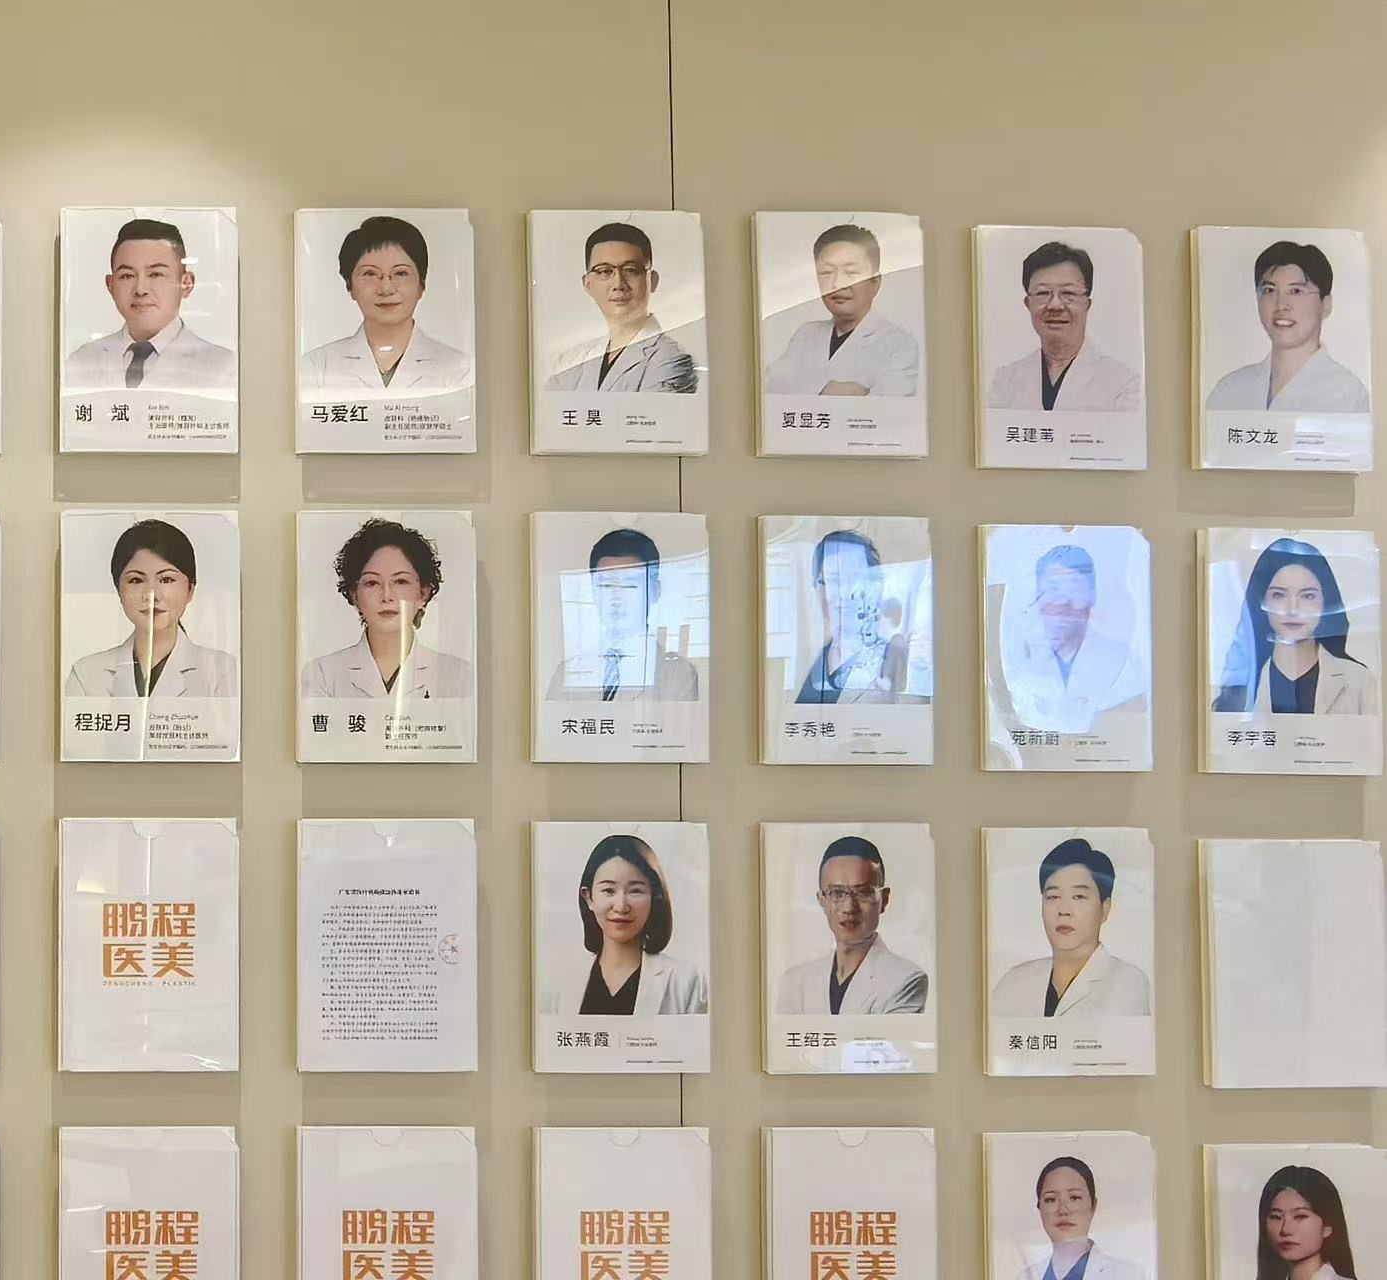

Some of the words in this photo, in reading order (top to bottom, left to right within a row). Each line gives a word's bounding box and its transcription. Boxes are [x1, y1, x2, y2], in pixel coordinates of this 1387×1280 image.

[310, 404, 369, 424] 马爱红
[781, 411, 831, 429] 夏显芳
[1227, 427, 1279, 444] 陈文龙
[74, 712, 131, 733] 程捉月
[561, 718, 615, 735] 宋福民
[784, 721, 836, 738] 李秀艳
[102, 901, 196, 937] 鹏程
[102, 942, 195, 978] 医美
[556, 1031, 610, 1048] 张燕霞
[785, 1032, 838, 1048] 王绍云
[1008, 1034, 1058, 1050] 秦信阳
[105, 1209, 200, 1246] 鹏程
[341, 1209, 435, 1246] 鹏程
[580, 1209, 671, 1246] 鹏程
[809, 1209, 898, 1246] 鹏程
[105, 1249, 199, 1280] 医美
[341, 1249, 434, 1280] 医美
[580, 1249, 670, 1280] 医美
[809, 1249, 897, 1280] 医美
